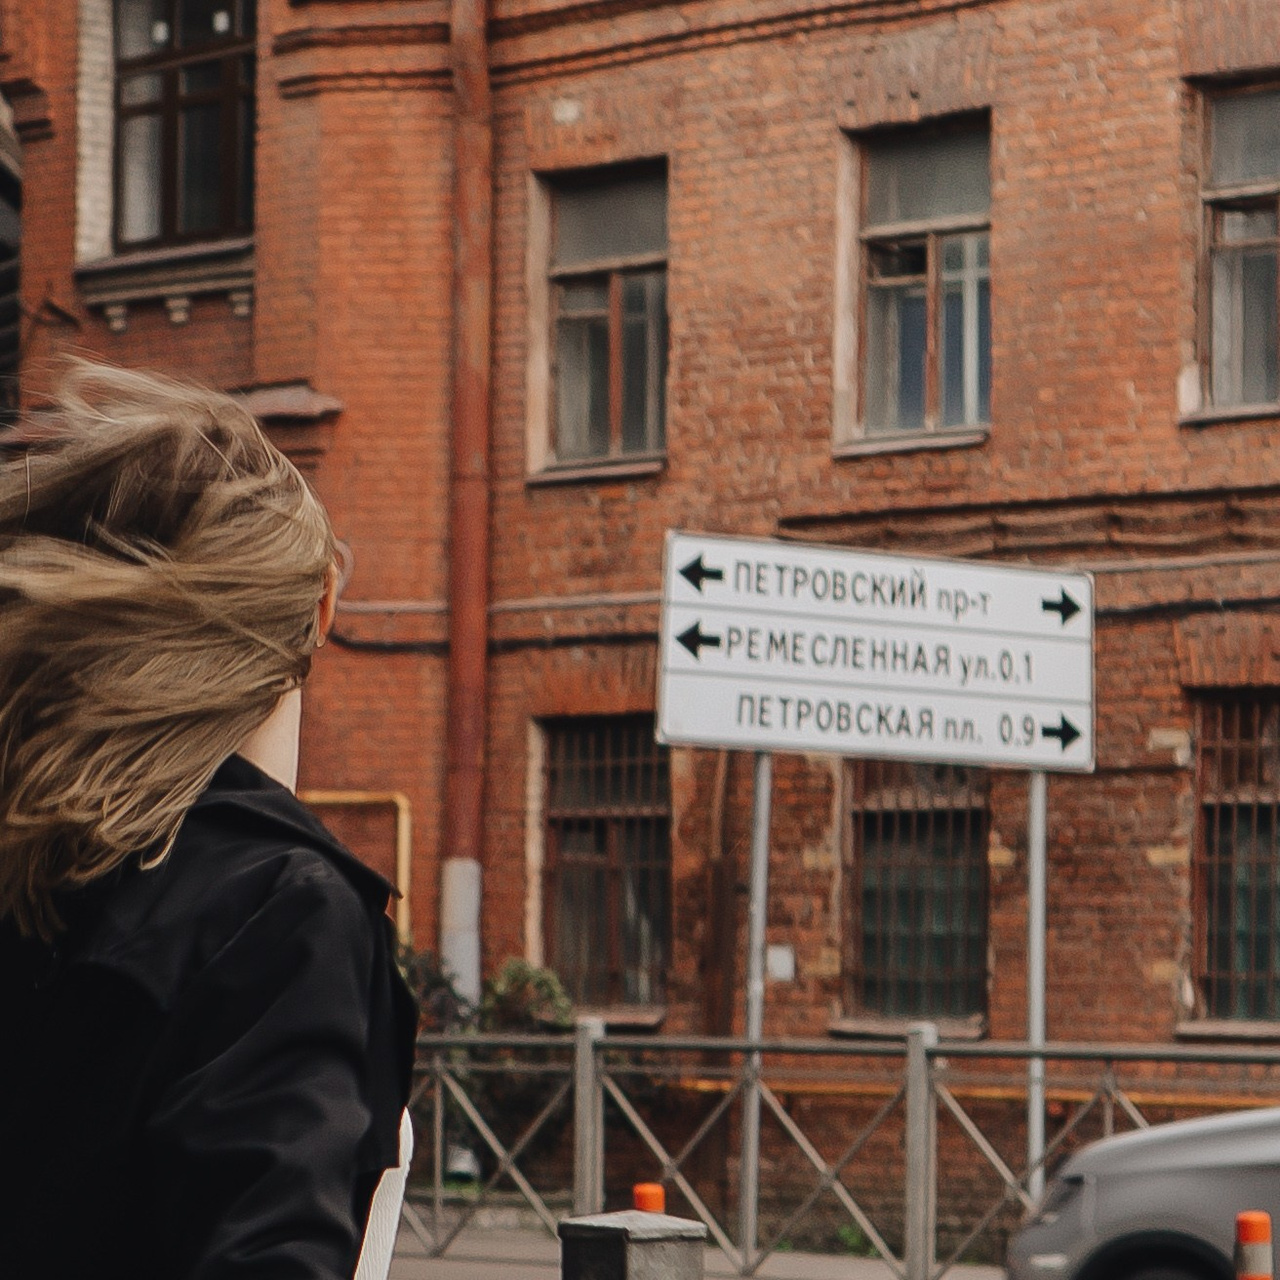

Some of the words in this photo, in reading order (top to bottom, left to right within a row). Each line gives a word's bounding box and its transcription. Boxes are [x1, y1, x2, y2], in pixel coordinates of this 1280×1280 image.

[735, 559, 926, 609] ПЕТРОВСКИЙ
[937, 588, 991, 621] пр-т
[726, 626, 950, 675] РЕМЕСЛЕННАЯ
[737, 694, 933, 739] ПЕТРОВСКАЯ
[944, 717, 983, 742] пл.
[999, 713, 1035, 746] 0.9
